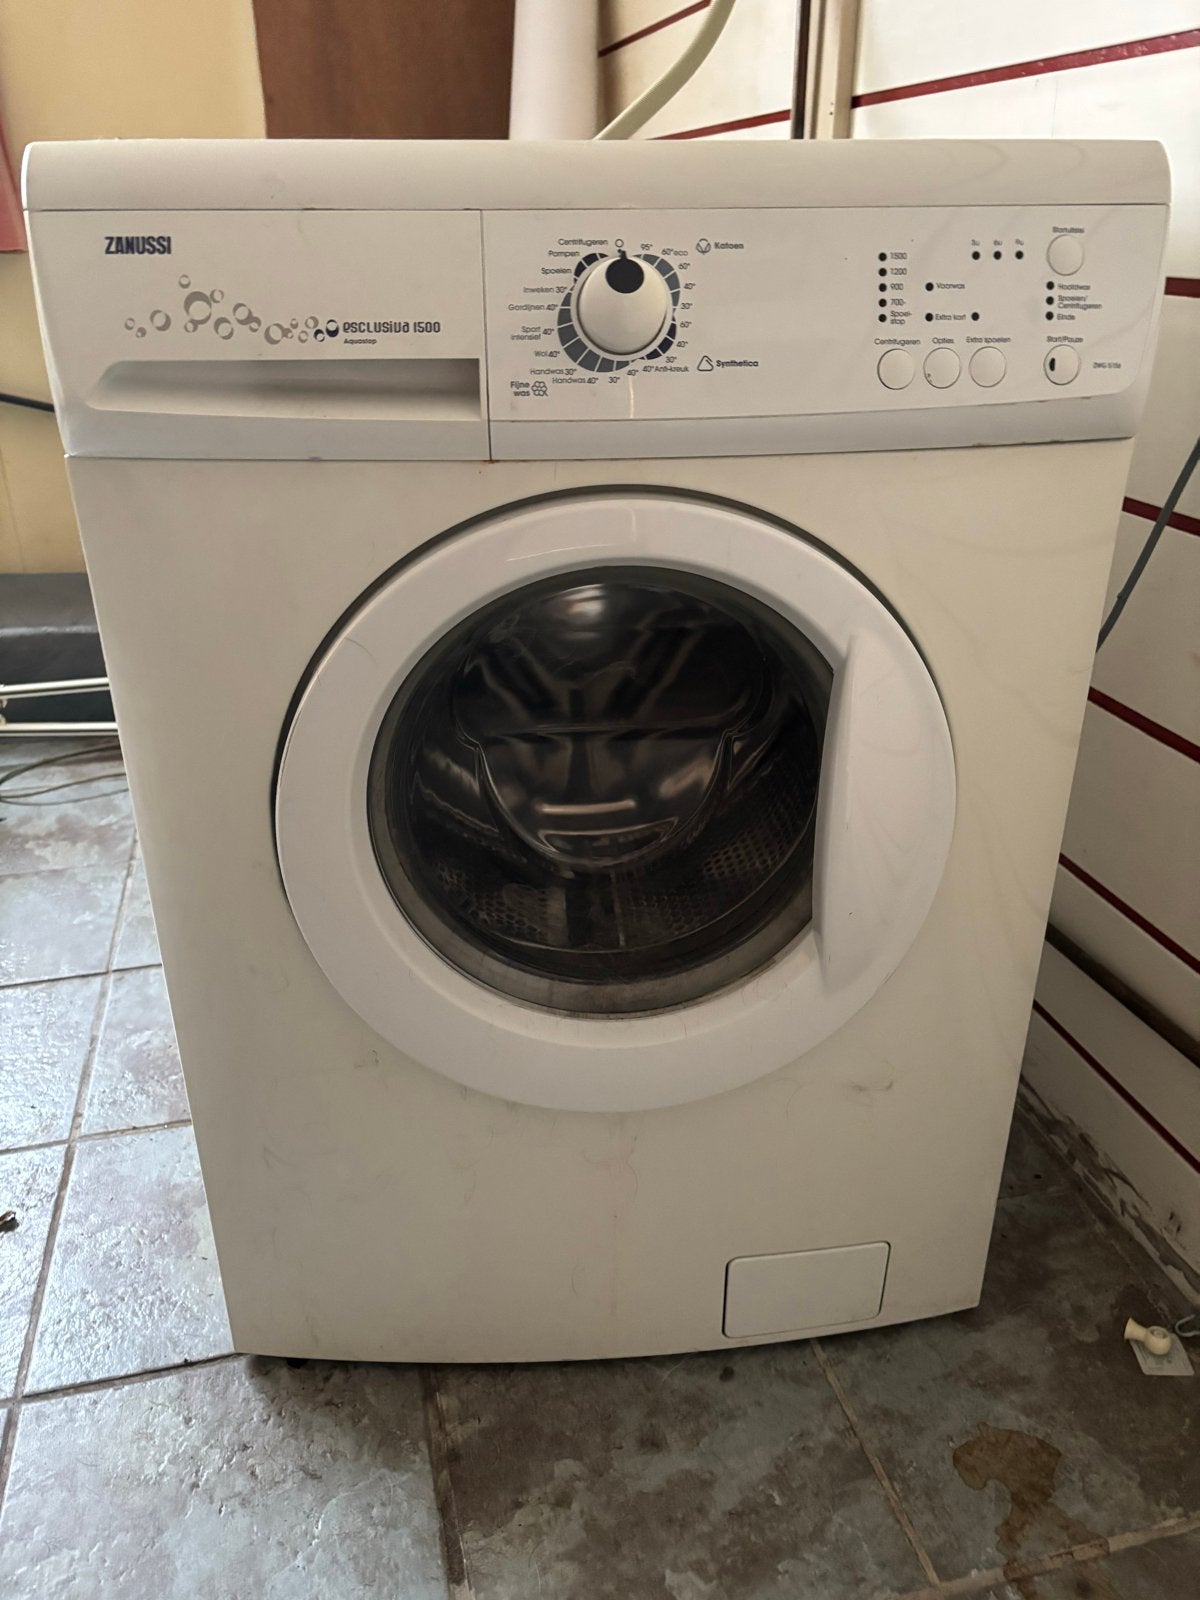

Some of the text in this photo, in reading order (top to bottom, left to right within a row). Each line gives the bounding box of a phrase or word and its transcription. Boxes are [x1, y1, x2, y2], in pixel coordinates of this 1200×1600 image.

[105, 236, 171, 254] ZANUSSI
[558, 238, 608, 246] Centrifugeren
[714, 241, 744, 249] Katoen
[890, 252, 907, 260] 1500
[890, 268, 907, 276] 1200
[413, 322, 441, 333] 1500
[874, 338, 921, 346] Centrifugeren
[931, 337, 954, 345] Opties
[966, 336, 983, 344] Extra
[716, 359, 759, 368] Synthetica
[510, 382, 530, 390] Fijne
